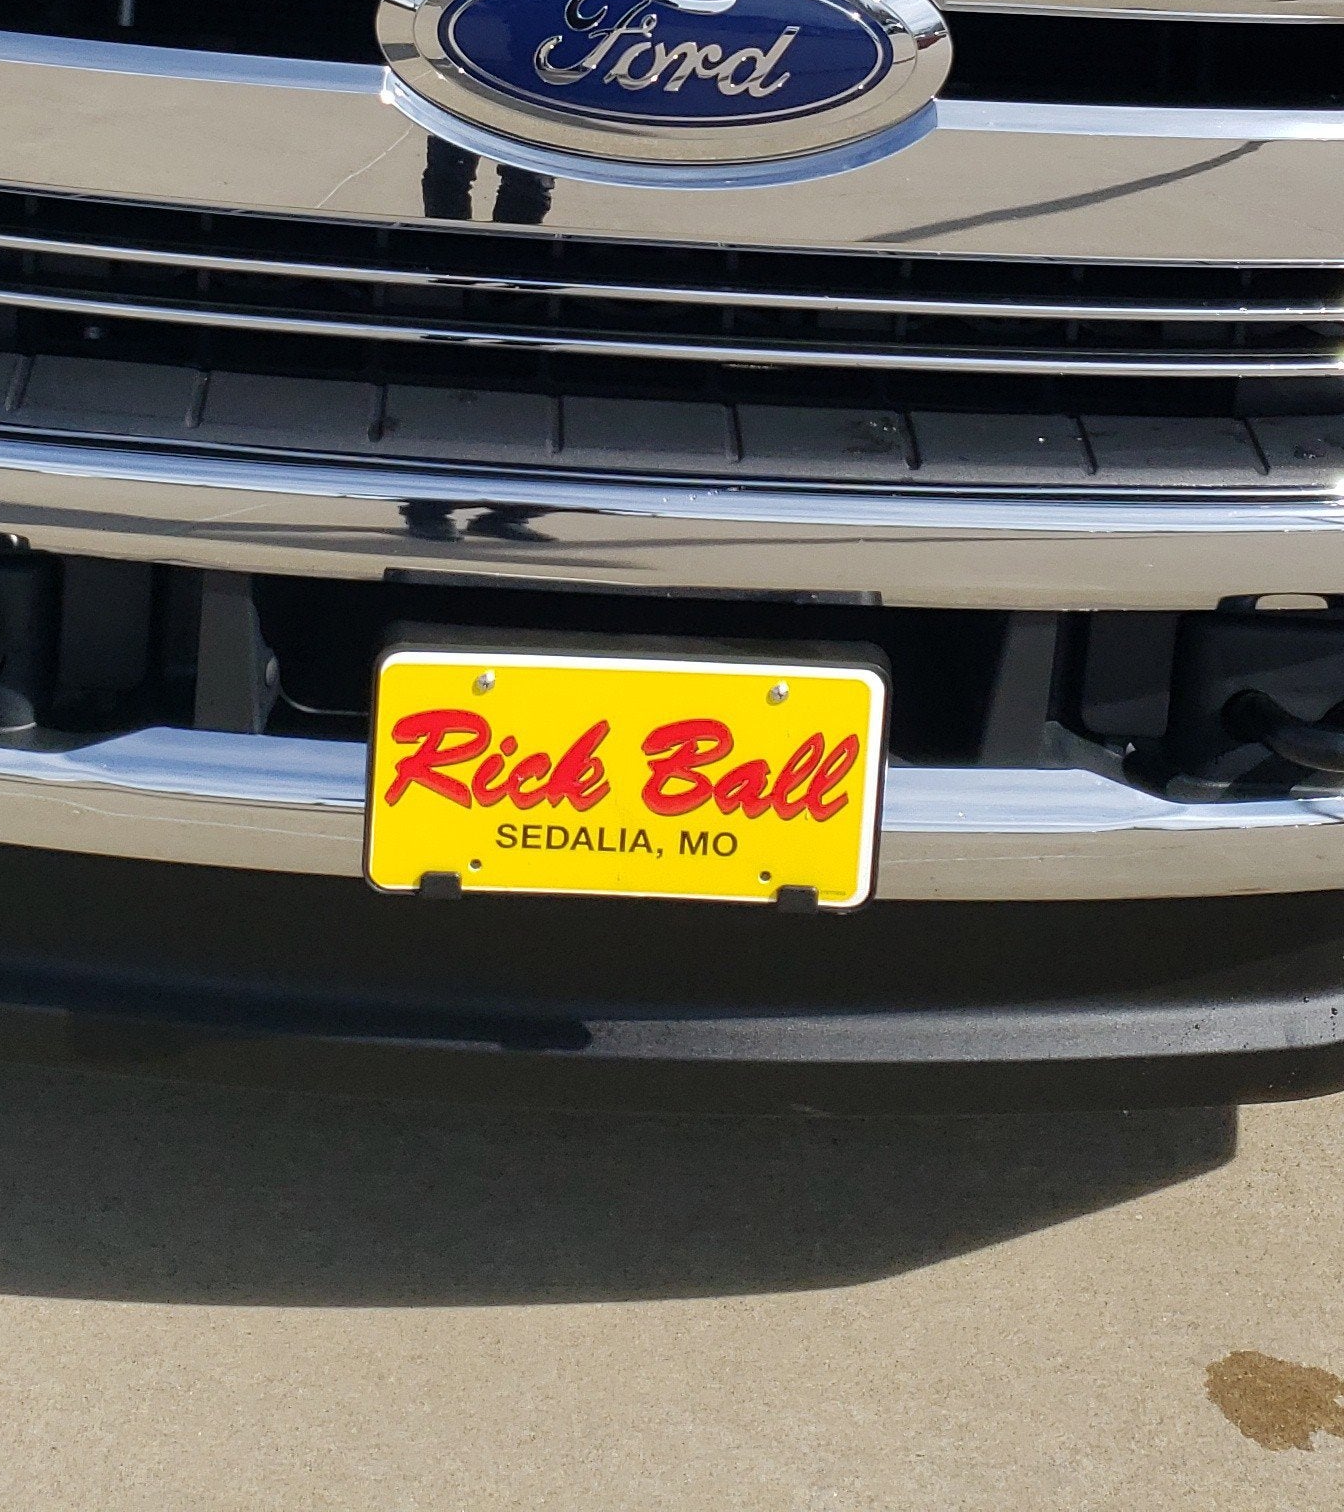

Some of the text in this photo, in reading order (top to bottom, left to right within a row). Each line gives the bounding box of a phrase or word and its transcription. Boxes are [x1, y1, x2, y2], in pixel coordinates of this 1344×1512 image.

[385, 709, 860, 822] Rick Ball
[496, 824, 739, 859] SEDALIA, MO
